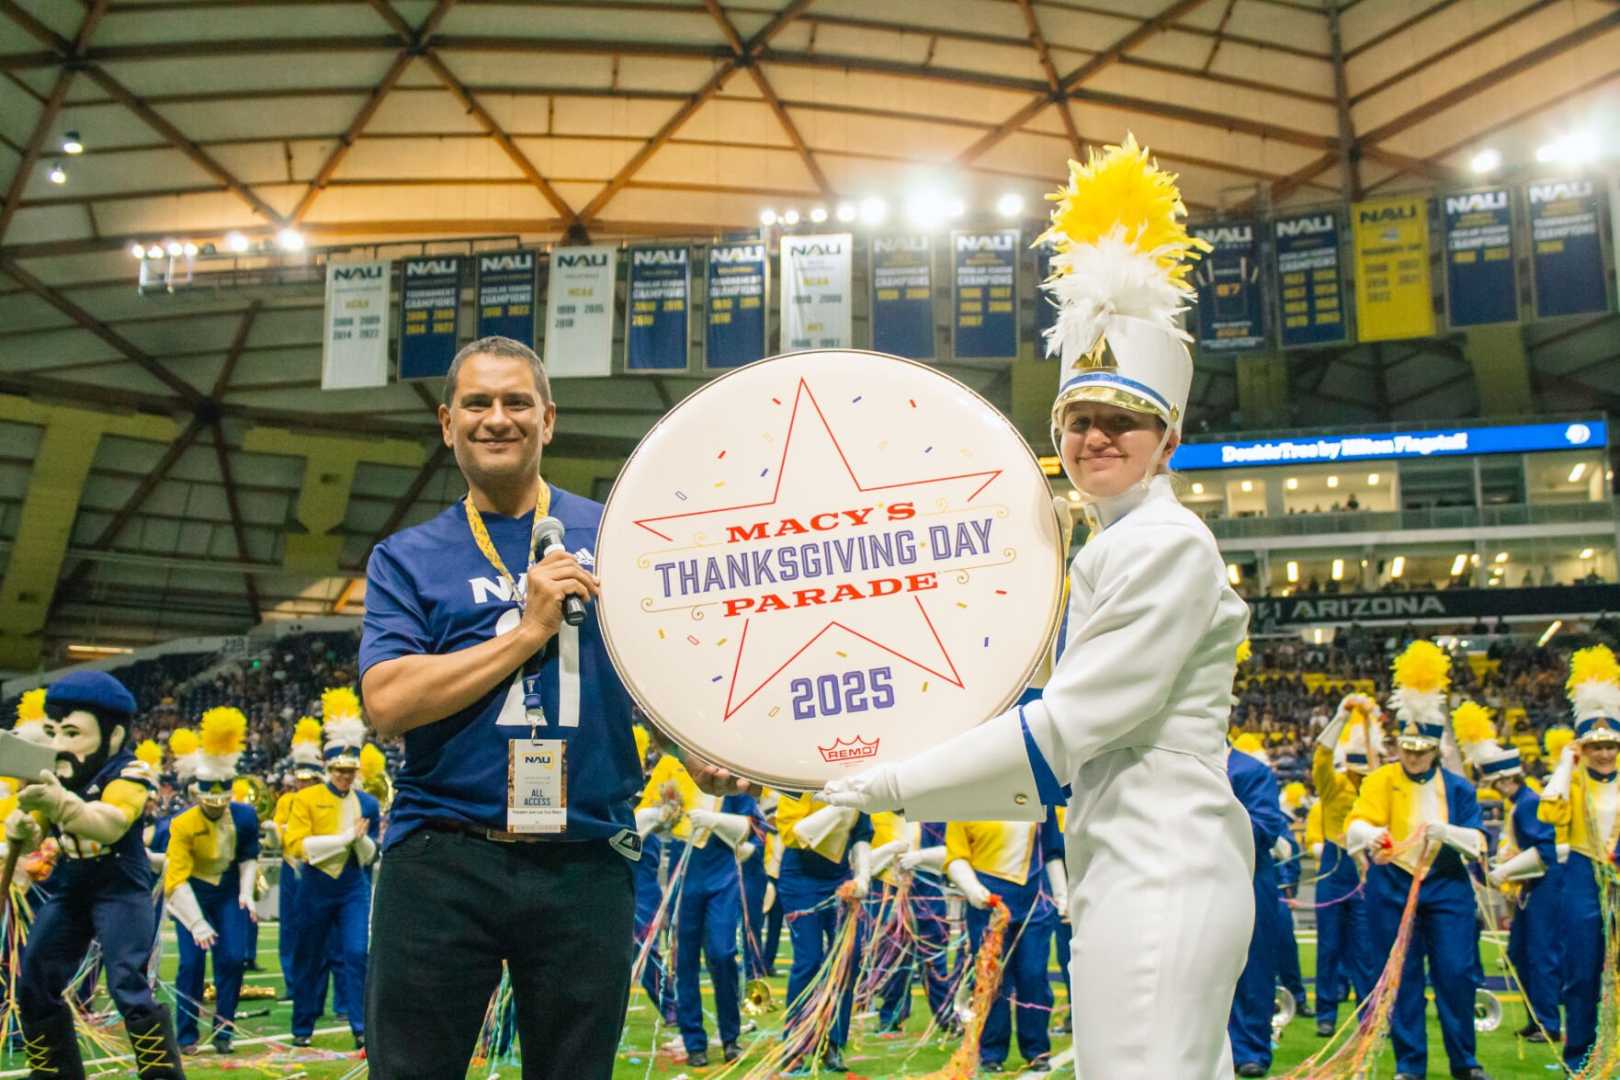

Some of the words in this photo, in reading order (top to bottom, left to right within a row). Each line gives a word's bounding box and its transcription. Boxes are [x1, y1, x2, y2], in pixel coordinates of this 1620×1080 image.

[1530, 181, 1593, 203] NAU
[1446, 192, 1507, 214] NAU
[1360, 205, 1416, 224] NAU
[1276, 215, 1333, 238] NAU
[791, 242, 841, 257] NAU
[958, 236, 1013, 251] NAU
[481, 253, 532, 272] NAU
[557, 254, 608, 268] NAU
[634, 249, 688, 266] NAU
[710, 246, 764, 263] NAU
[334, 265, 383, 281] NAU
[406, 259, 458, 276] NAU
[655, 530, 917, 597] THANKSGIVING
[929, 518, 993, 560] DAY
[723, 572, 938, 617] PARADE
[1292, 596, 1445, 618] ARIZONA
[790, 666, 895, 720] 2025
[525, 756, 551, 764] NAU
[828, 746, 872, 759] REMO
[531, 788, 544, 798] ALL
[523, 798, 551, 807] ACCESS
